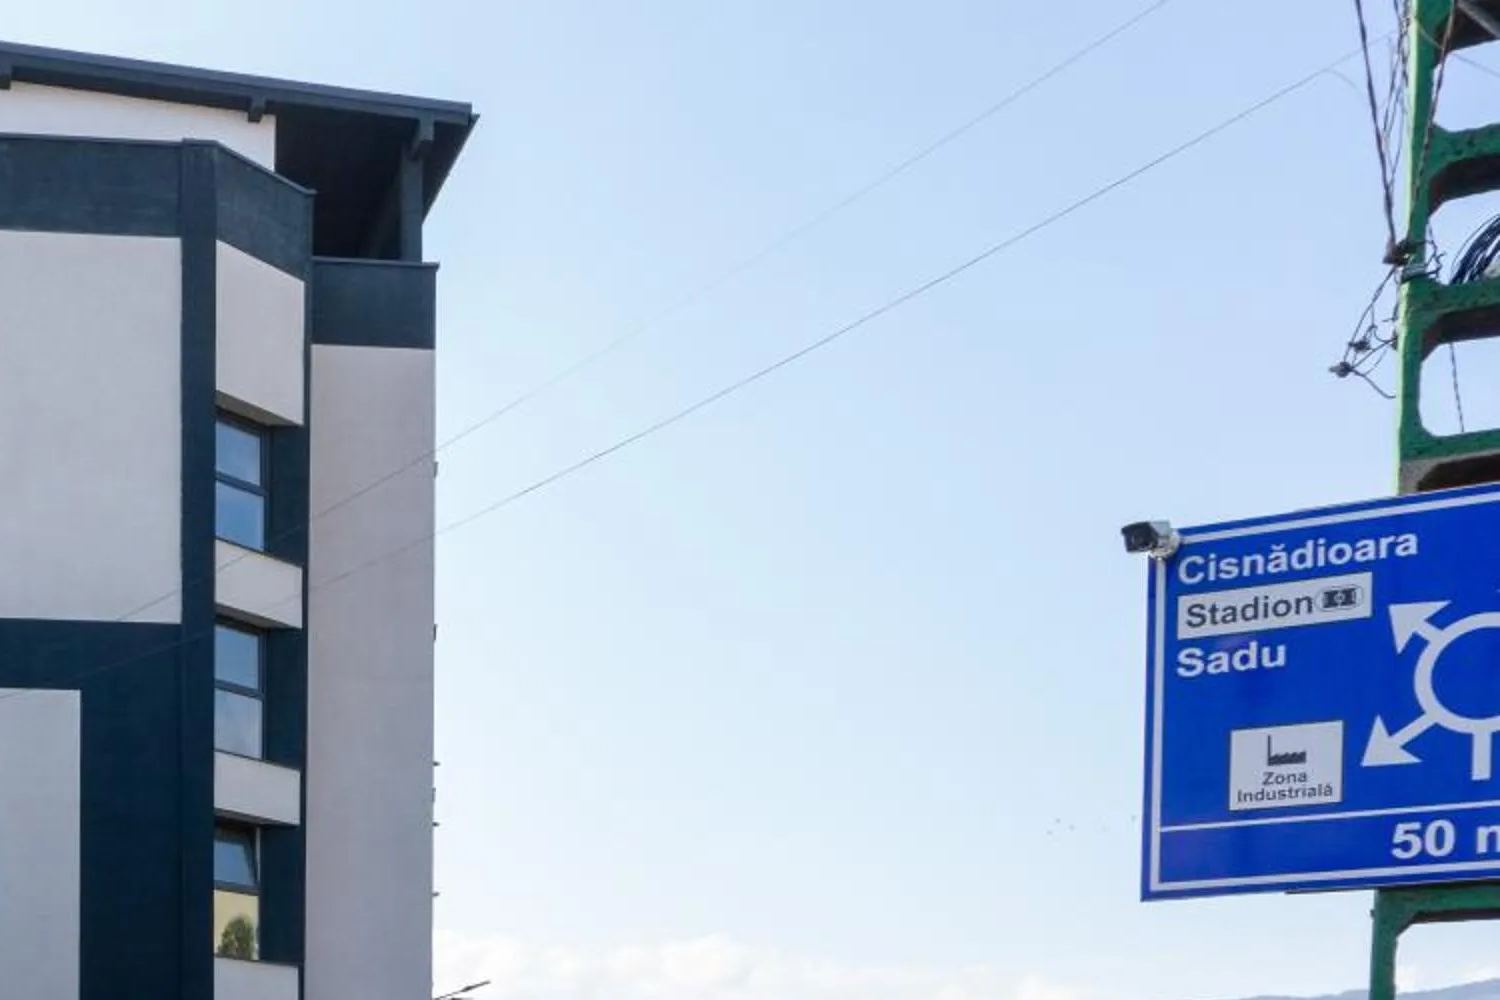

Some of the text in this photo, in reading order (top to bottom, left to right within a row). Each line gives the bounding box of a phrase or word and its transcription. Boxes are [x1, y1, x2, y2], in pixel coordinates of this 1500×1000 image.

[1178, 533, 1419, 585] Cisnădioara
[1186, 594, 1313, 629] Stadion
[1177, 641, 1287, 678] Sadu
[1237, 783, 1333, 803] Industrială
[1262, 771, 1308, 785] Zona
[1391, 819, 1456, 859] 50
